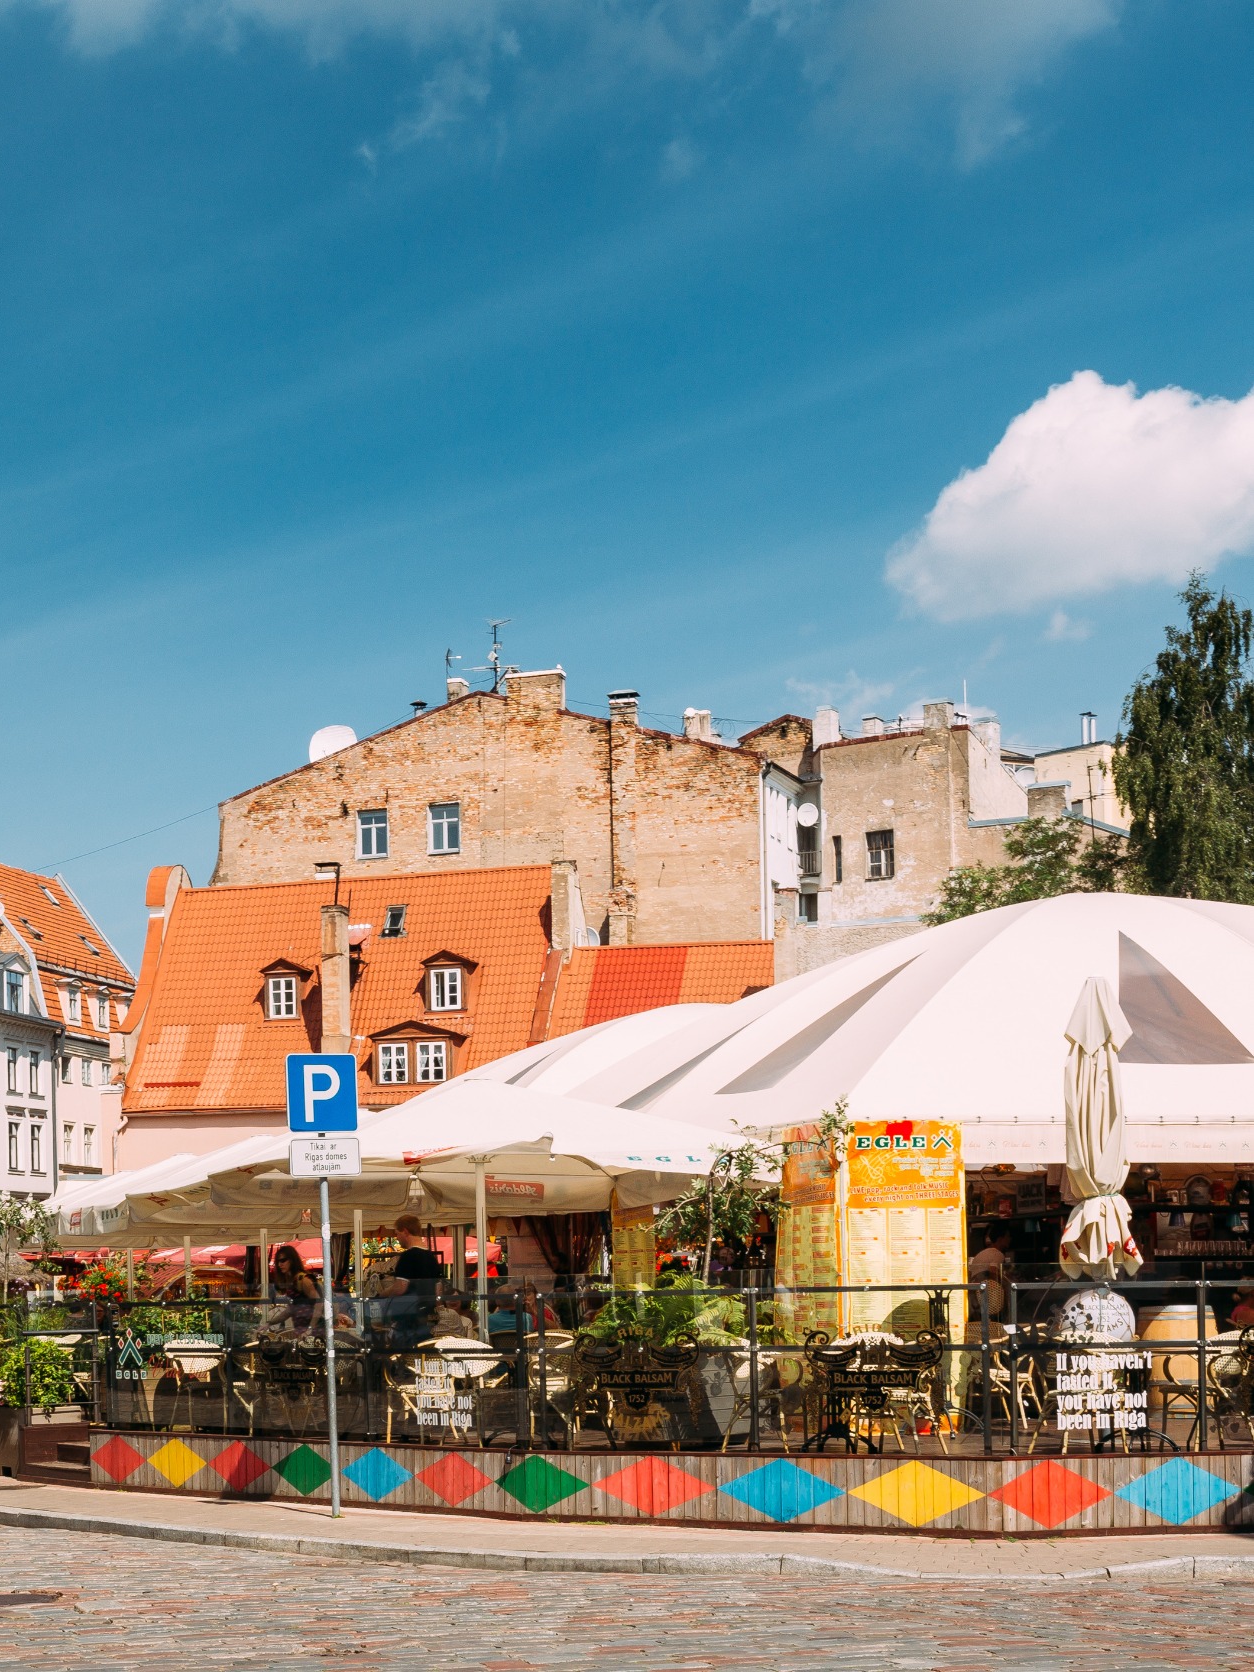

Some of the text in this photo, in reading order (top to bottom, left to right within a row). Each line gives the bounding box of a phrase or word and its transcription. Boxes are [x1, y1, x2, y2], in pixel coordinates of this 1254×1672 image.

[303, 1064, 340, 1123] P
[310, 1142, 325, 1151] Tikai
[783, 1141, 814, 1155] GLE
[856, 1136, 926, 1149] EGLE
[305, 1152, 347, 1163] Rīgas domes
[850, 1186, 864, 1194] LIVE
[864, 1195, 883, 1203] every
[885, 1193, 903, 1202] night
[937, 1190, 959, 1198] STAGES
[1056, 1353, 1067, 1371] If
[1071, 1355, 1097, 1375] you
[115, 1369, 147, 1379] EGLE
[601, 1371, 673, 1384] BLACK BALSAM
[833, 1372, 913, 1384] BLACK BALSAM
[1056, 1372, 1098, 1391] tasted
[457, 1394, 473, 1410] not
[628, 1394, 645, 1403] 1752
[864, 1395, 882, 1405] 1752
[1056, 1390, 1148, 1413] you have not
[417, 1410, 473, 1428] been in Riga
[1057, 1409, 1147, 1430] been in Riga
